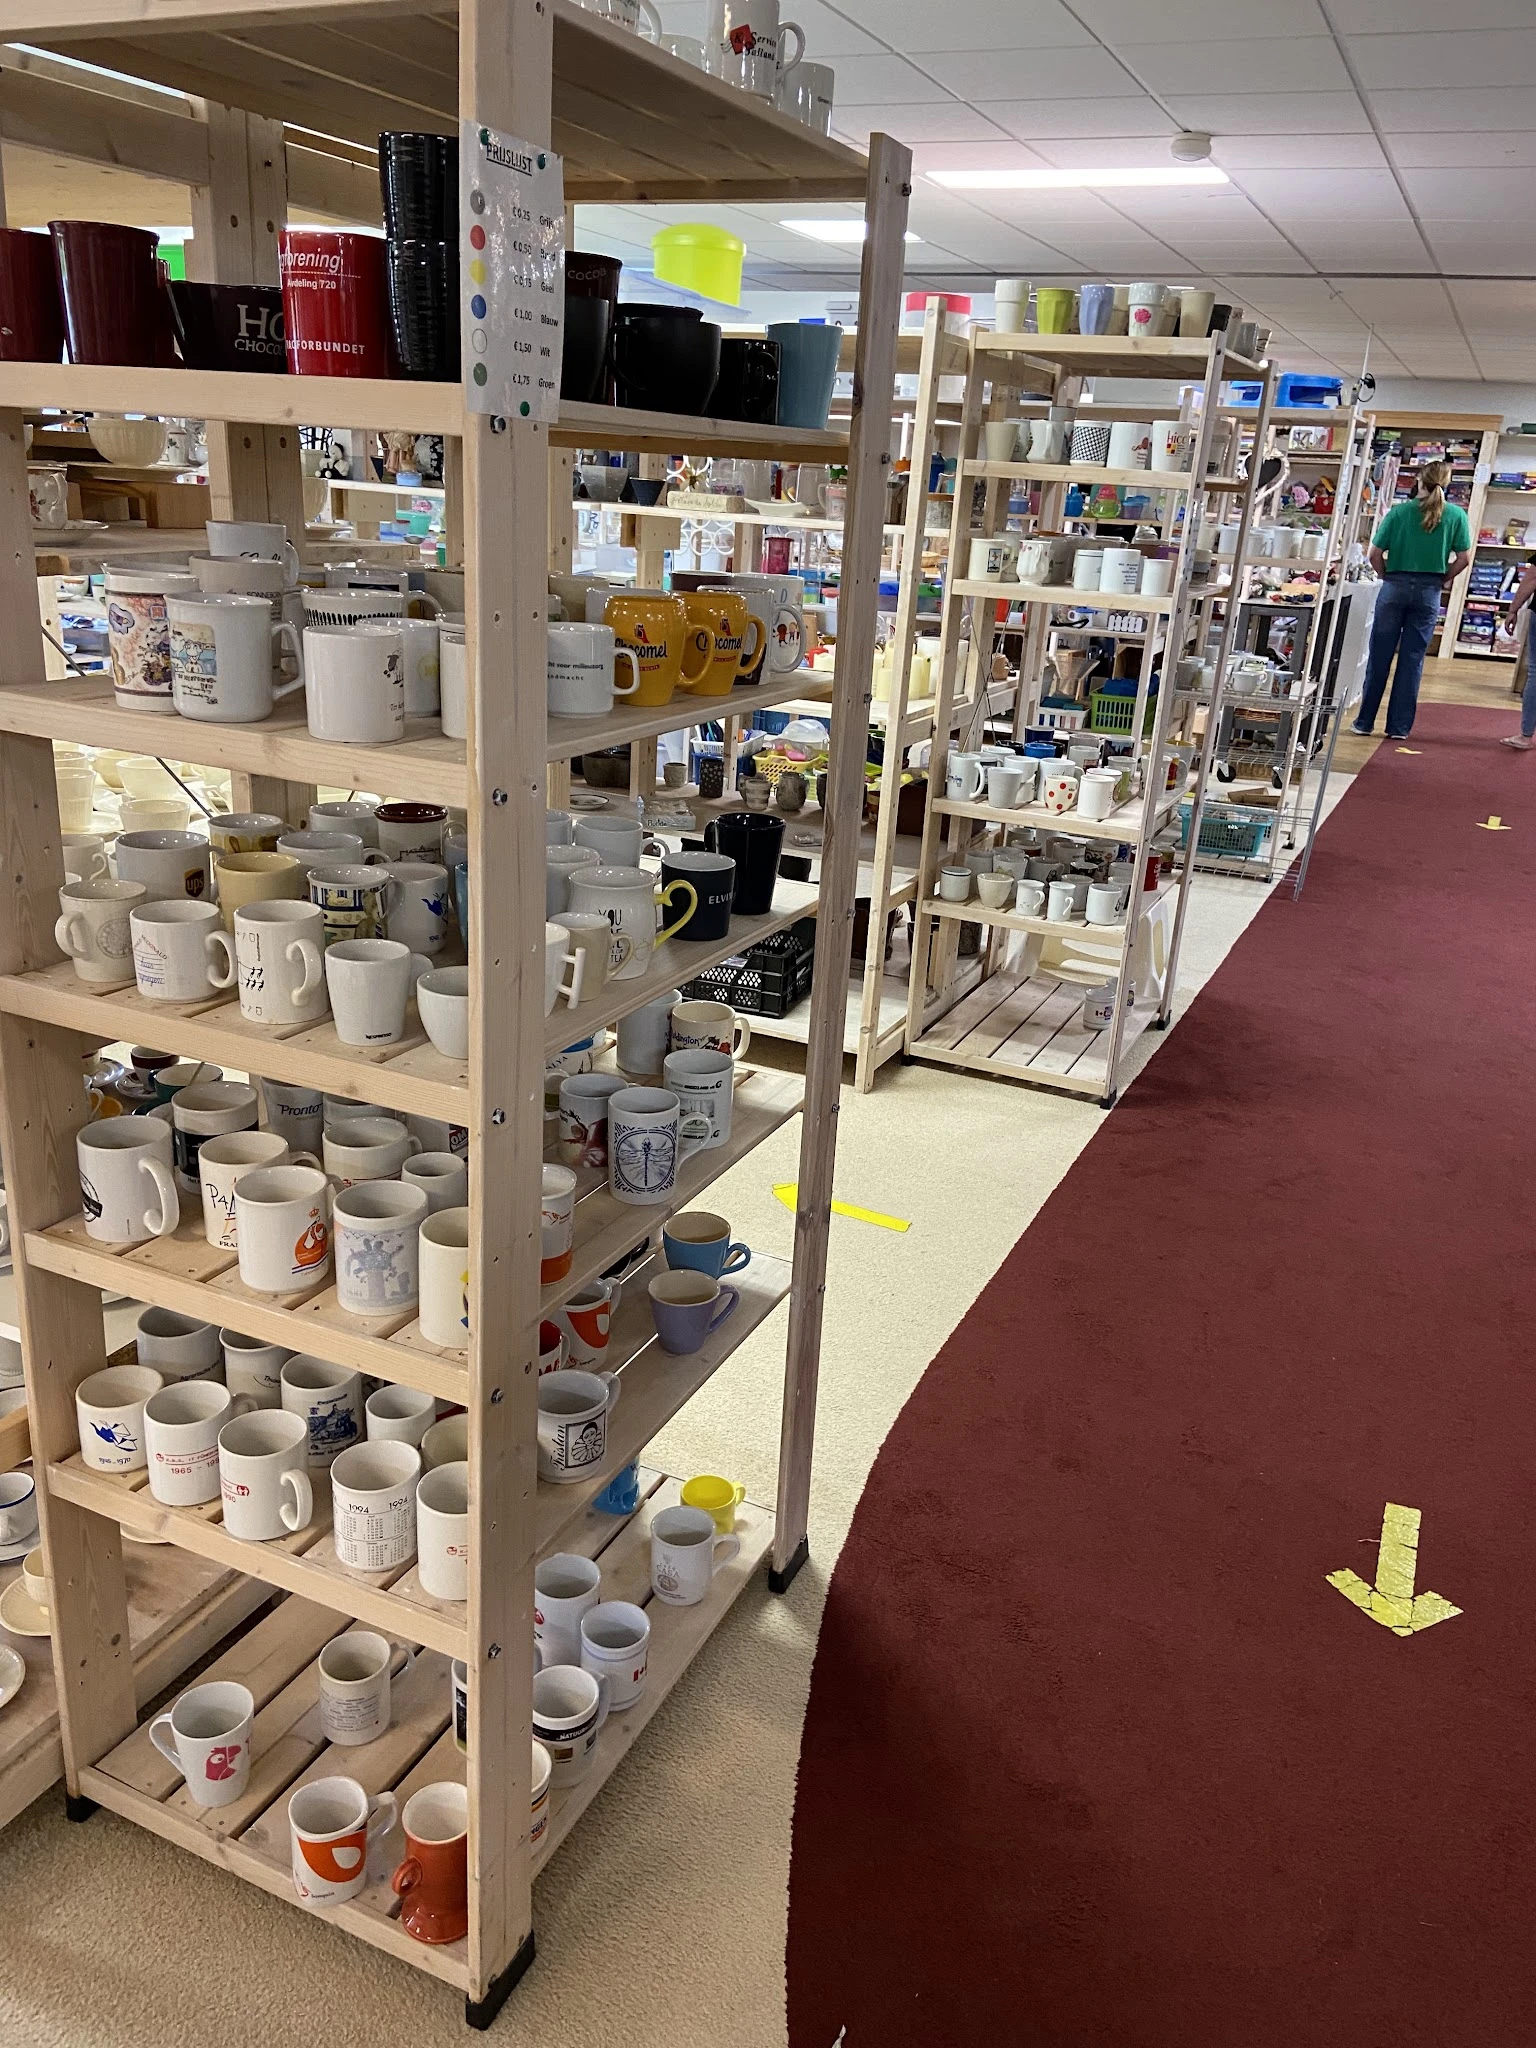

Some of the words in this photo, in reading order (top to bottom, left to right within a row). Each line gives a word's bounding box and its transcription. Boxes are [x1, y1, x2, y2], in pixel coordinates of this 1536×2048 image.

[287, 278, 318, 290] Avdeling
[320, 280, 337, 290] 720
[520, 309, 532, 321] 1,00
[540, 314, 559, 327] Blauw
[519, 343, 532, 354] 1,50
[540, 345, 551, 358] Wit
[518, 374, 530, 386] 1,75
[538, 378, 556, 389] Groen
[615, 637, 668, 659] Chcomel
[696, 632, 743, 651] Chcomel
[186, 880, 205, 895] ups
[278, 1104, 323, 1116] Pronto
[171, 1466, 192, 1475] 1965
[348, 1503, 369, 1514] 1994
[389, 1496, 408, 1510] 1994
